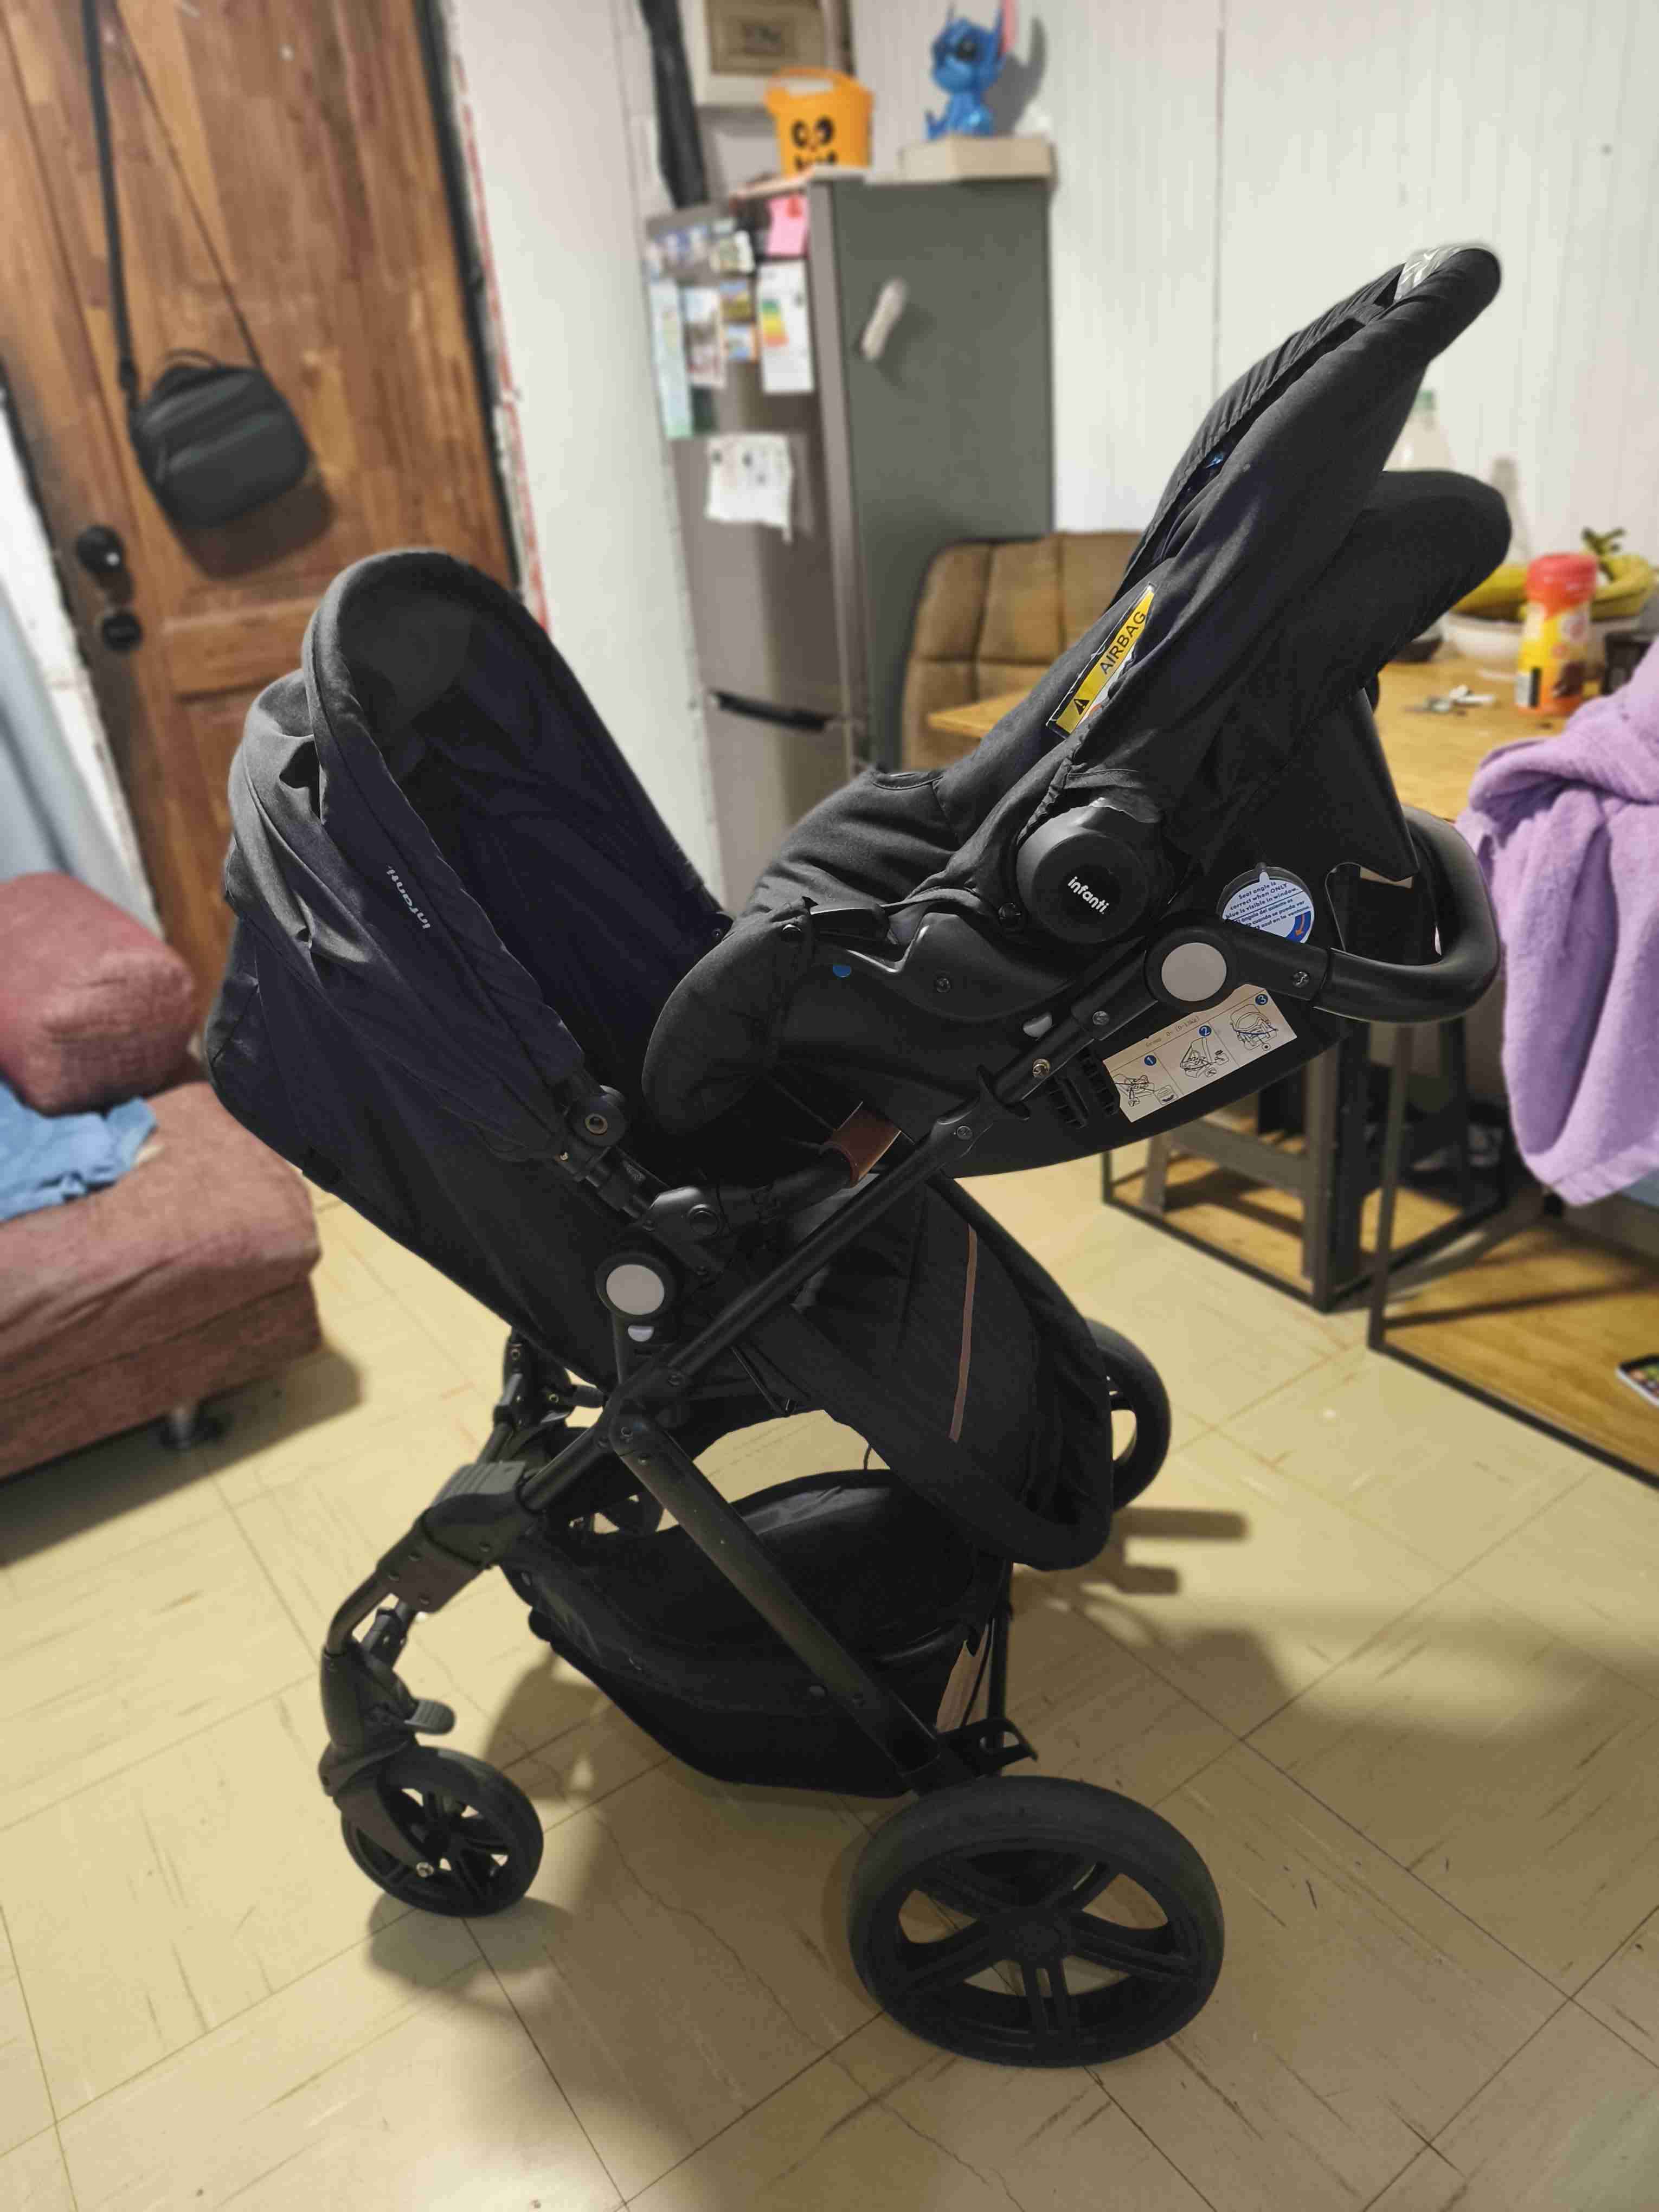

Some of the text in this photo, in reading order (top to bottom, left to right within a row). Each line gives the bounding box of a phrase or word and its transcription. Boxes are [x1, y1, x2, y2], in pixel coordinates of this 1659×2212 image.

[1099, 612, 1146, 674] AIRBAG
[1230, 883, 1288, 910] correct when ONLY
[1238, 890, 1252, 900] Seat
[1253, 884, 1270, 894] angle
[1225, 910, 1239, 919] blue
[1246, 900, 1265, 911] visible
[1252, 915, 1271, 924] cuando
[1261, 920, 1272, 928] azul
